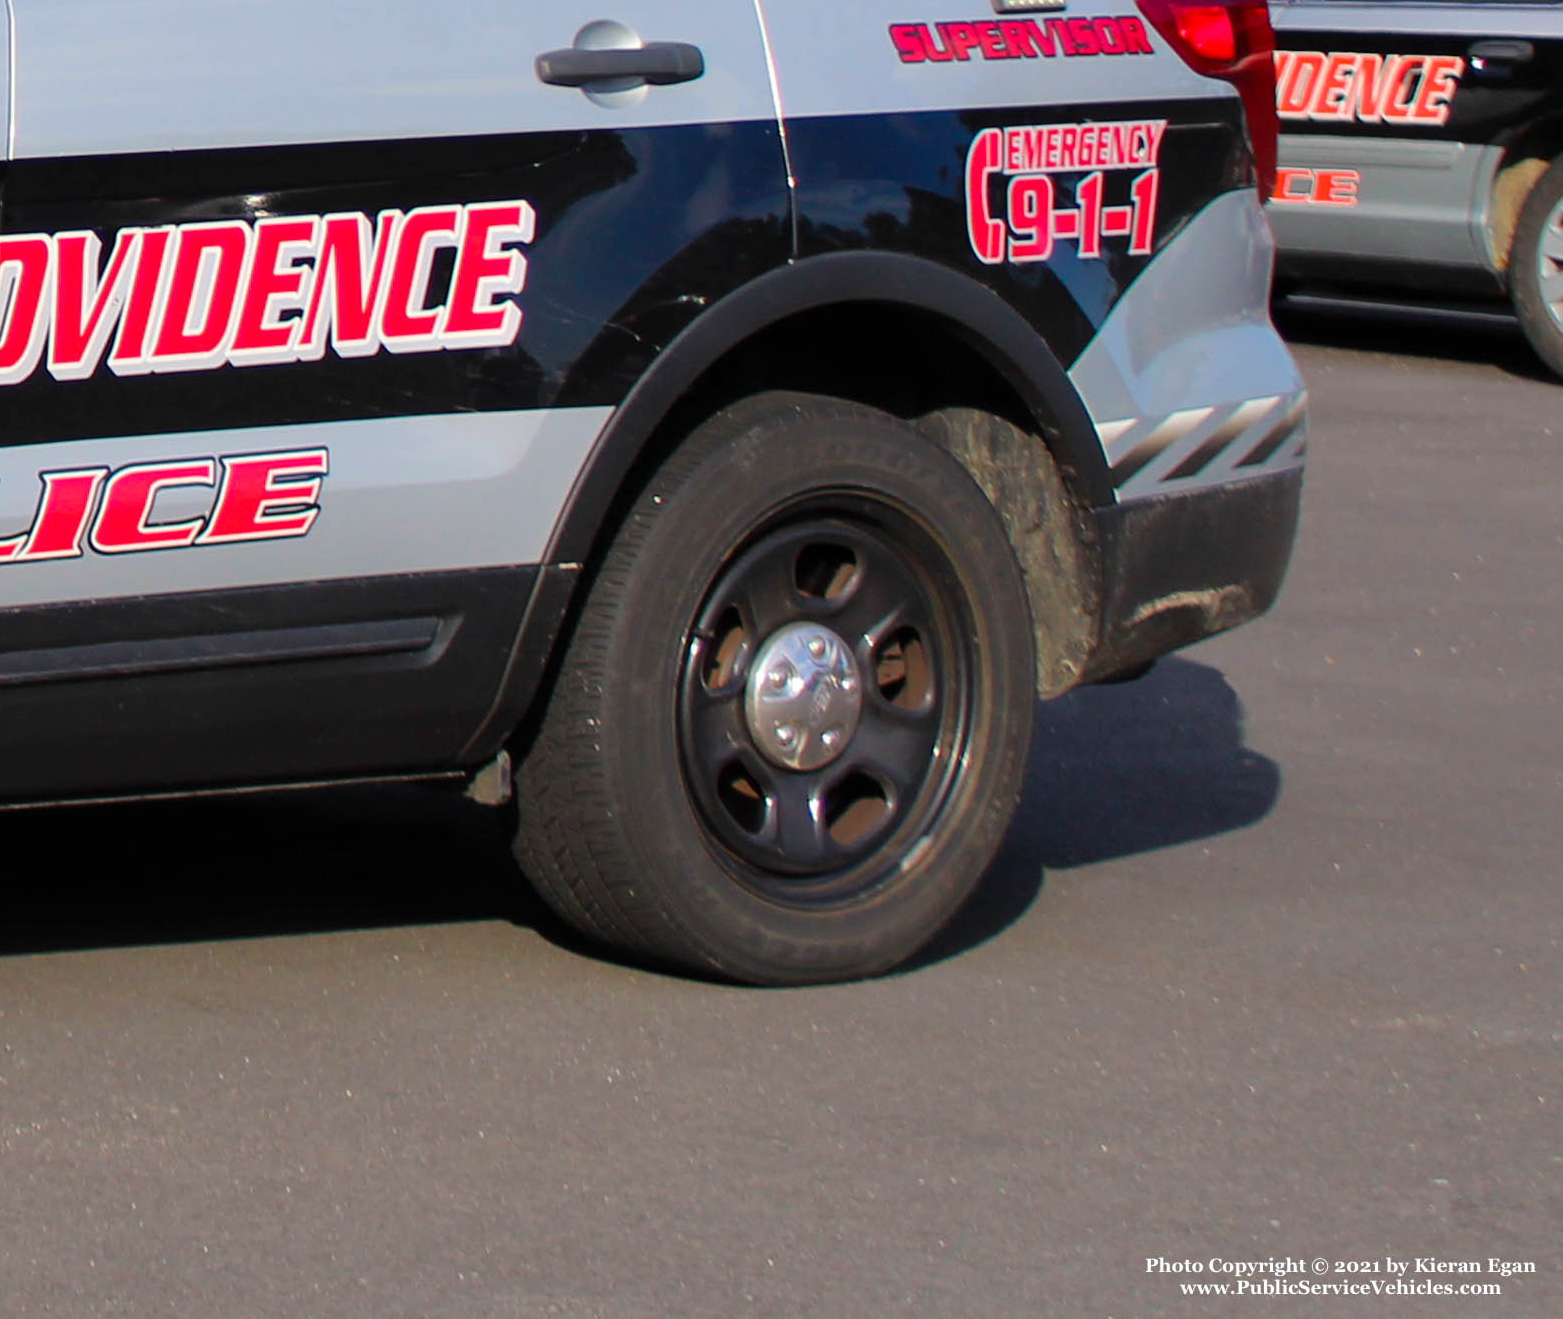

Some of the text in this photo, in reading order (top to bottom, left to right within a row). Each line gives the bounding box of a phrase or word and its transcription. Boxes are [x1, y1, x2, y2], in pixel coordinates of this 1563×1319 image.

[888, 15, 1156, 63] SUPERVISOR
[1003, 119, 1169, 174] EMERGENCY
[1006, 168, 1162, 262] 9-1-1
